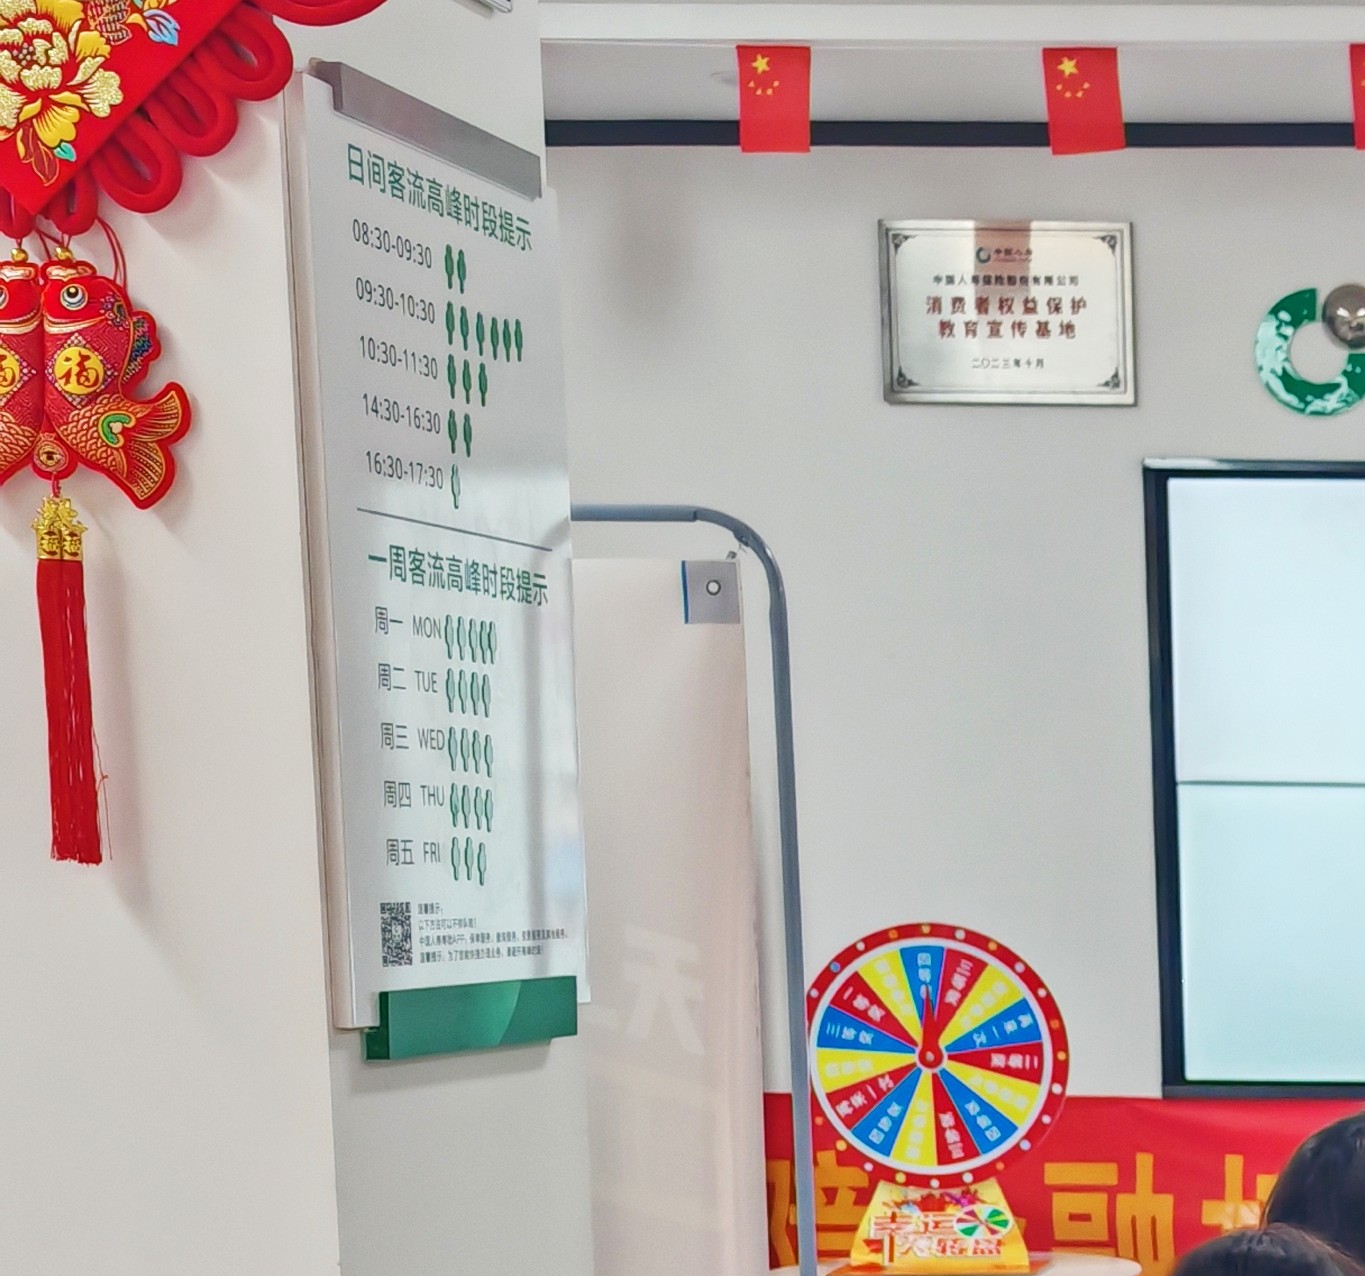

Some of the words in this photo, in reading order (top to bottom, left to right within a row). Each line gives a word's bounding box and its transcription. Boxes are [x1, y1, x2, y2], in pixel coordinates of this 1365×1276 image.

[347, 142, 532, 251] 日间客流高峰时段提示
[352, 218, 432, 269] 08:30-09:30
[355, 277, 436, 325] 09:30-10:30
[926, 295, 1087, 316] 消费者权益保护
[938, 319, 1076, 340] 教育宣传基地
[57, 356, 99, 392] 福
[359, 335, 438, 380] 10:30-11:30
[362, 392, 441, 435] 14:30-16:30
[365, 450, 443, 490] 16:30-17:30
[368, 544, 549, 607] 一周客流高峰时段提示
[374, 605, 404, 636] 周一
[412, 614, 442, 642] MON
[377, 662, 407, 692] 周二
[414, 670, 438, 694] TUE
[380, 721, 410, 751] 周三
[417, 728, 446, 751] WED
[383, 780, 412, 809] 周四
[419, 784, 445, 807] THU
[385, 838, 415, 867] 周五
[422, 842, 441, 864] FRI
